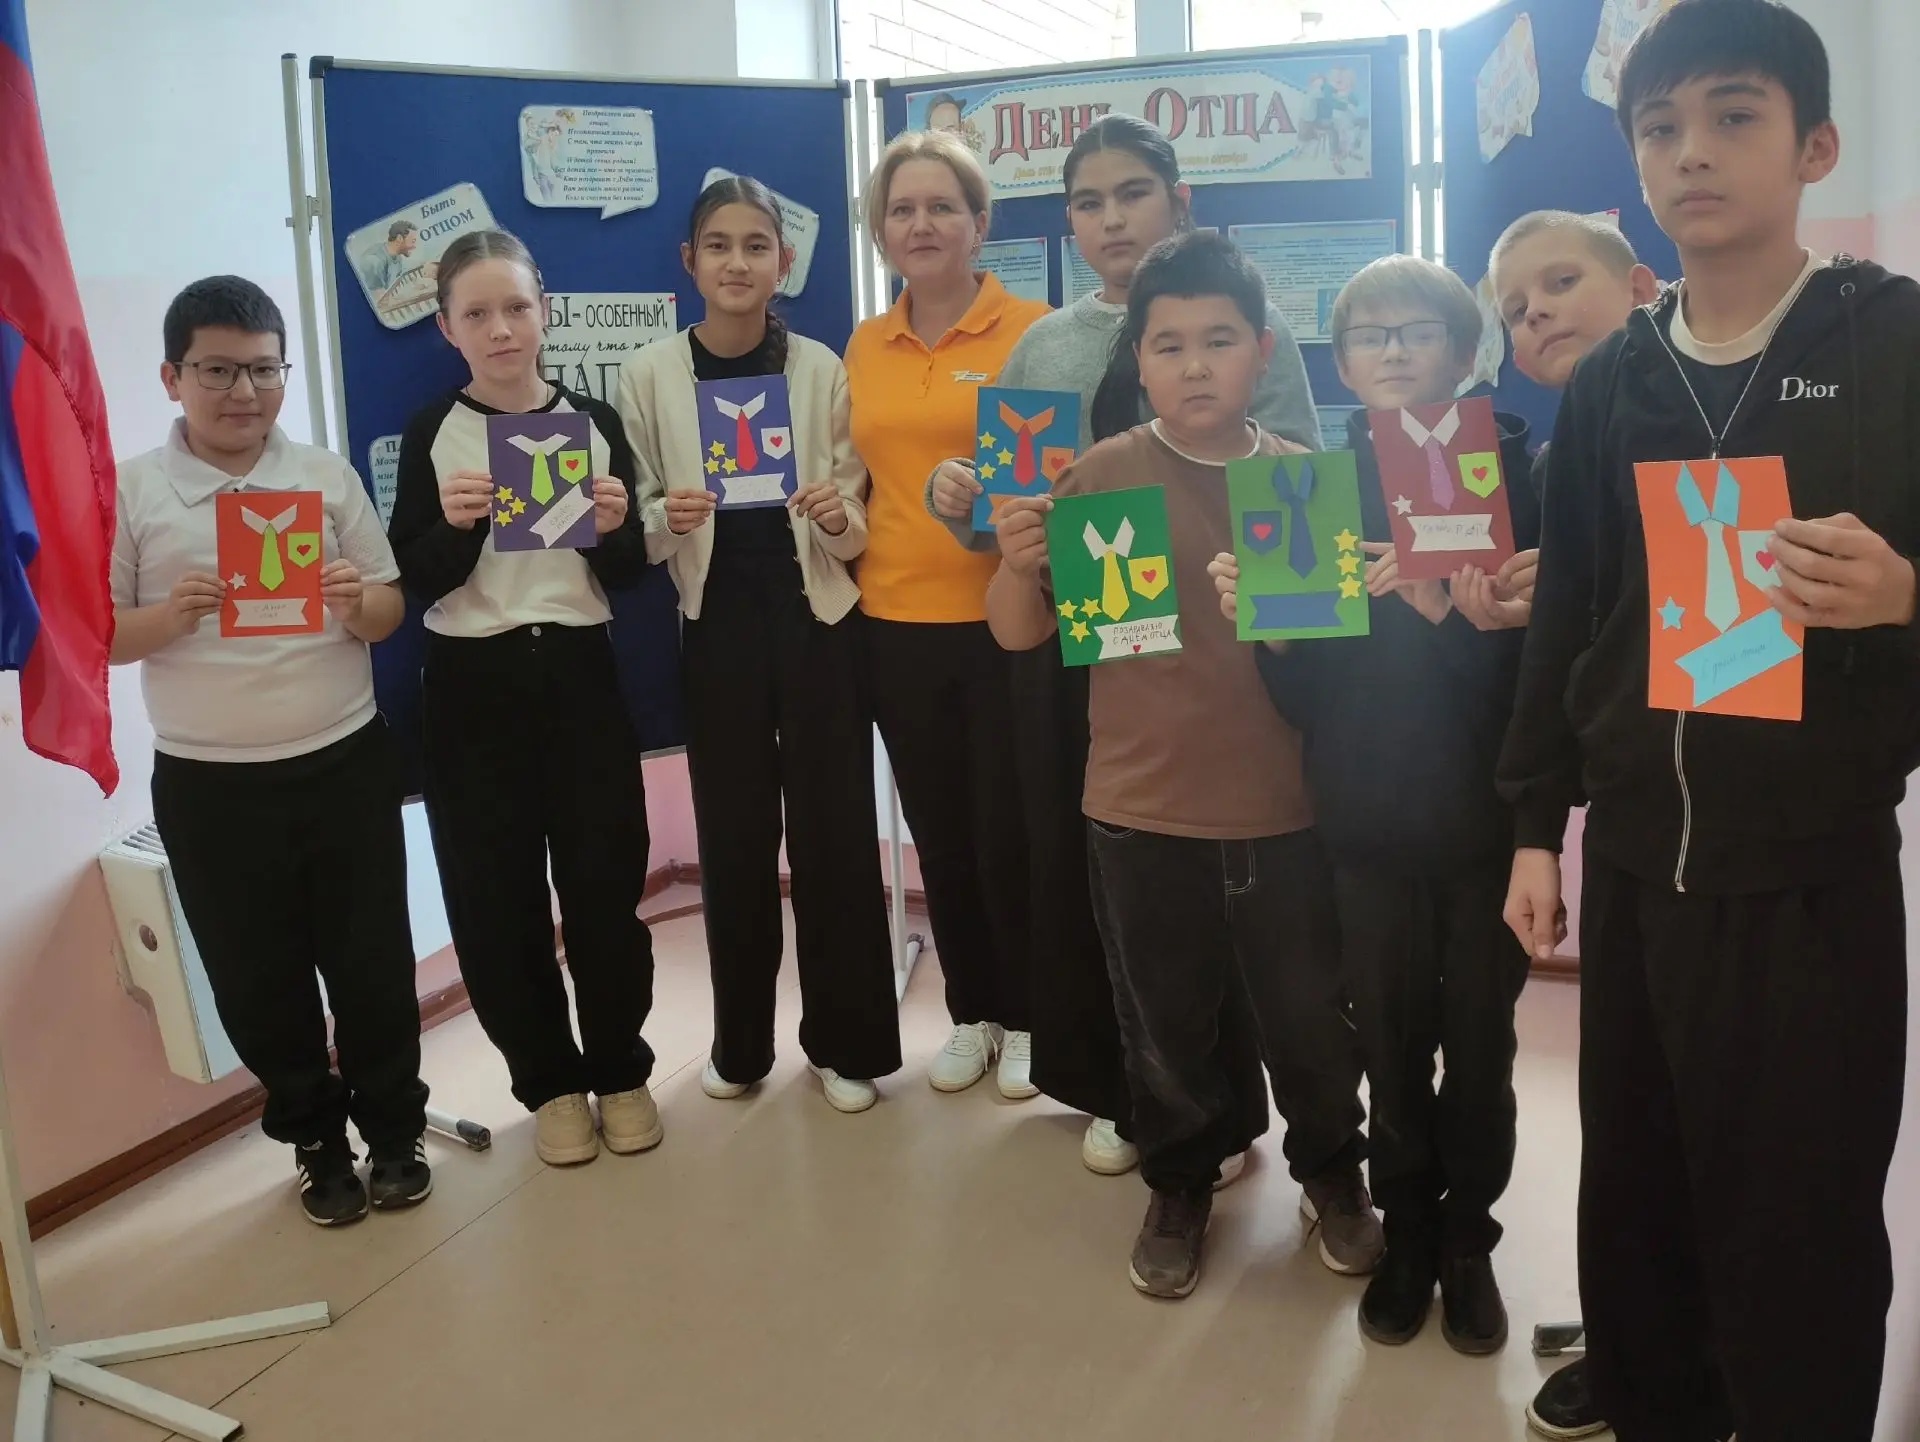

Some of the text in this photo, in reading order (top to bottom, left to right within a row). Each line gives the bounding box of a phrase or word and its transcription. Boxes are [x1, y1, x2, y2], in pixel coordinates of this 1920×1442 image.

[989, 87, 1298, 165] ДЕН ОТЦА
[420, 198, 456, 219] Быть
[420, 209, 475, 242] ОТЦОМ
[597, 341, 629, 352] что
[1778, 376, 1839, 401] Dior
